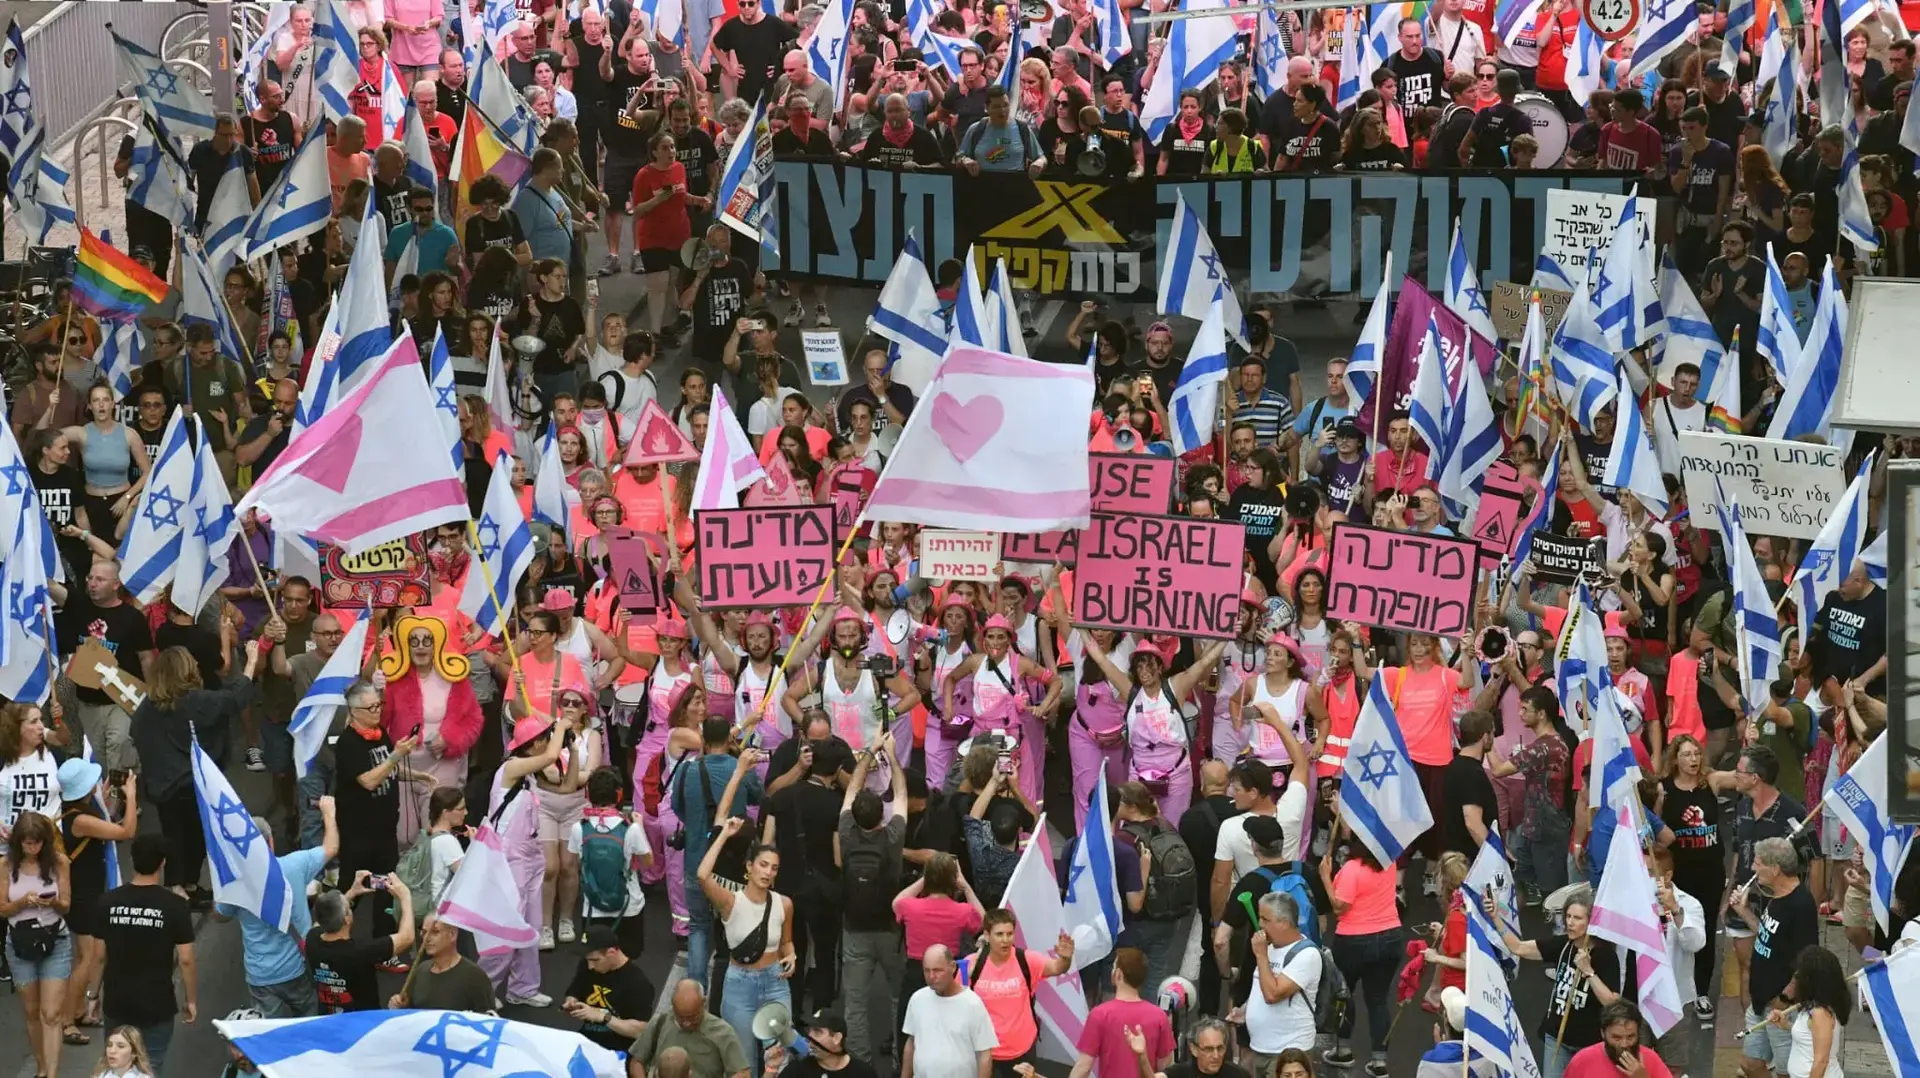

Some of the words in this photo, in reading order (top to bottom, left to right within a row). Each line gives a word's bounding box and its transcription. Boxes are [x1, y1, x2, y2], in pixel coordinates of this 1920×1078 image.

[1598, 1, 1623, 19] 4.2
[1570, 204, 1589, 216] אב
[1596, 202, 1613, 219] כל
[760, 161, 955, 284] תנצח
[1156, 177, 1623, 299] דמוקרטיה
[1774, 447, 1836, 467] אנחנו
[40, 488, 71, 506] דמו
[705, 510, 829, 549] מדינה
[929, 539, 993, 552] זהירות!
[1087, 514, 1231, 568] ISRAEL
[1533, 537, 1584, 557] דמוקרטיה
[348, 546, 405, 569] קרטיה
[1344, 532, 1466, 580] מדינה
[1543, 554, 1580, 570] כיבוש
[932, 563, 988, 576] כבאית
[1134, 566, 1173, 588] IS
[1082, 582, 1239, 634] BURNING
[1327, 581, 1465, 634] מופקרת
[14, 773, 49, 790] דמו
[12, 790, 49, 811] קרט
